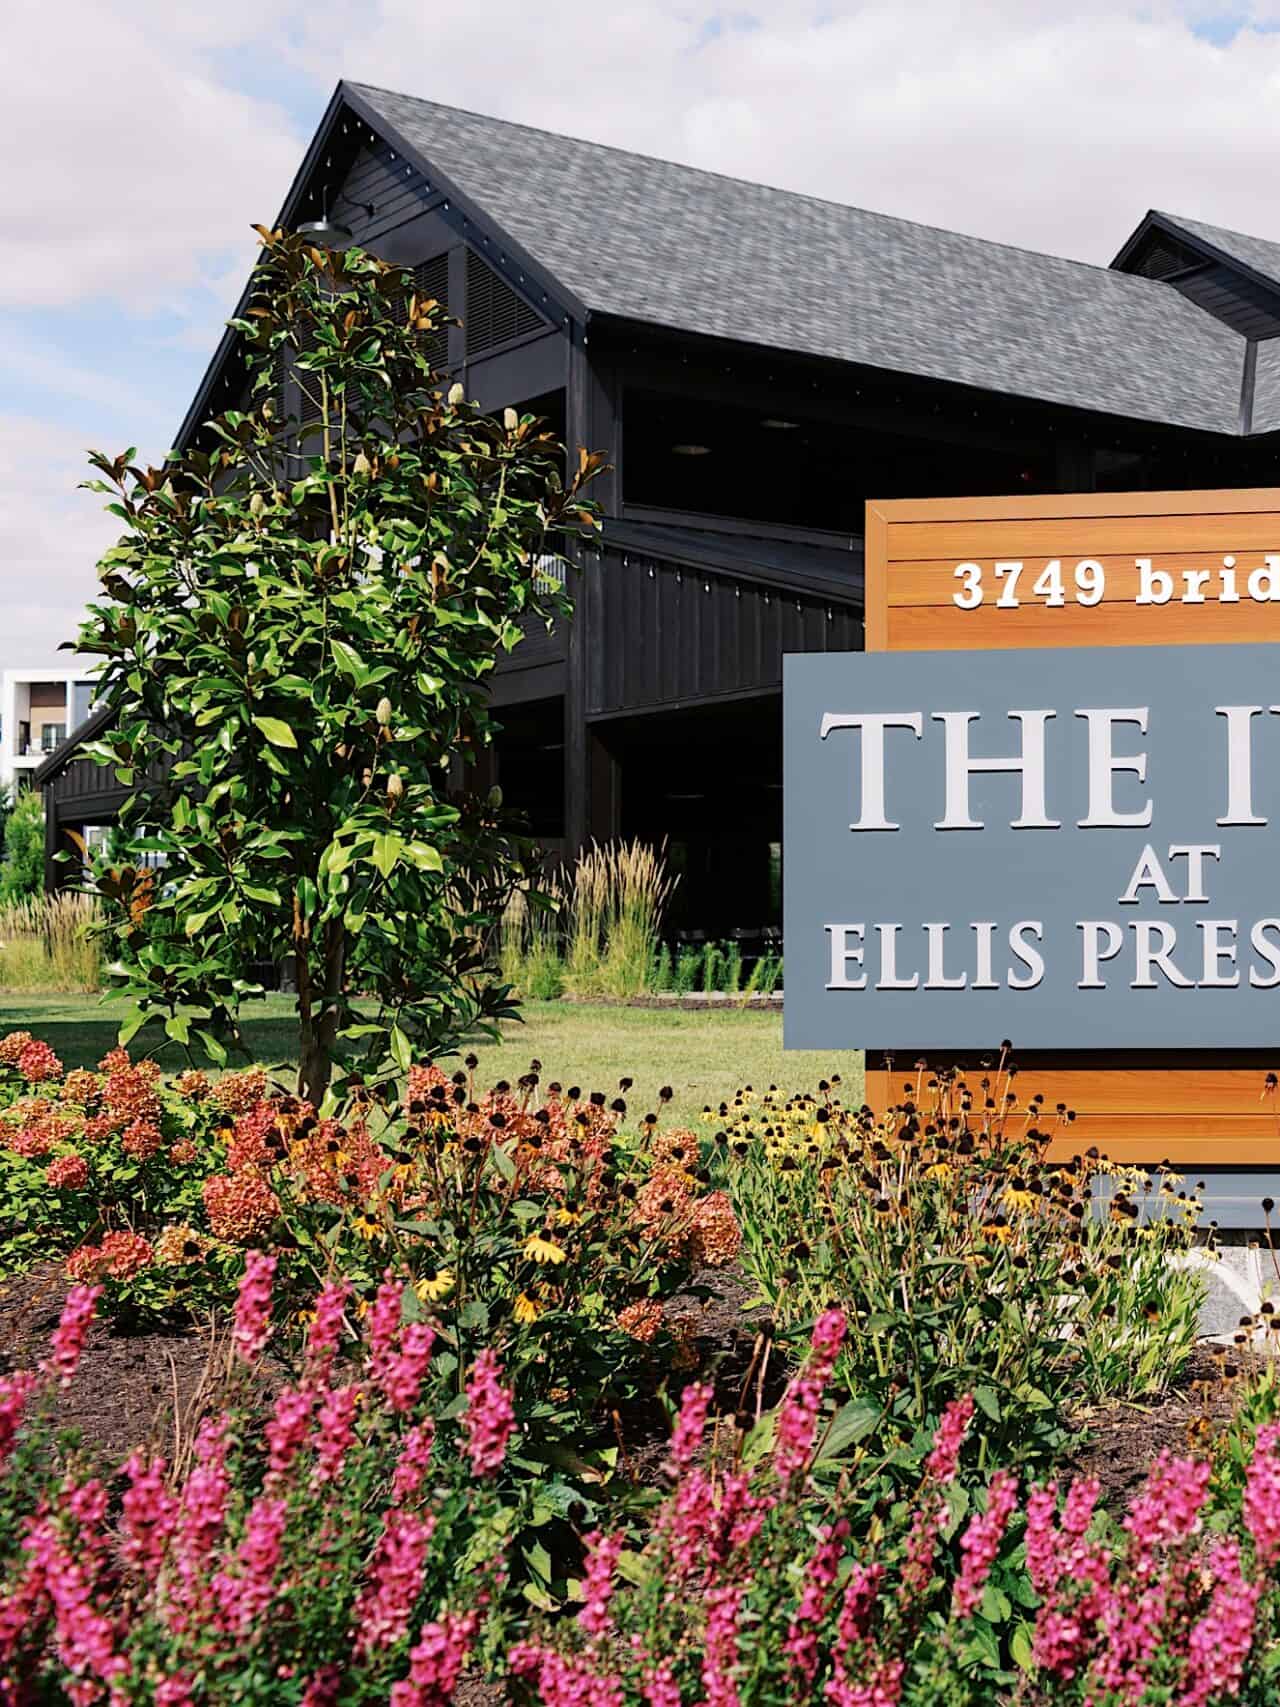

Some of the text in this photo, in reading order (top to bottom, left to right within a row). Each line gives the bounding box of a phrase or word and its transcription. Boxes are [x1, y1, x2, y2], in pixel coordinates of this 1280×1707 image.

[952, 559, 1106, 609] 3749
[820, 707, 1154, 831] THE
[1117, 844, 1221, 904] AT
[823, 921, 1045, 990] ELLIS
